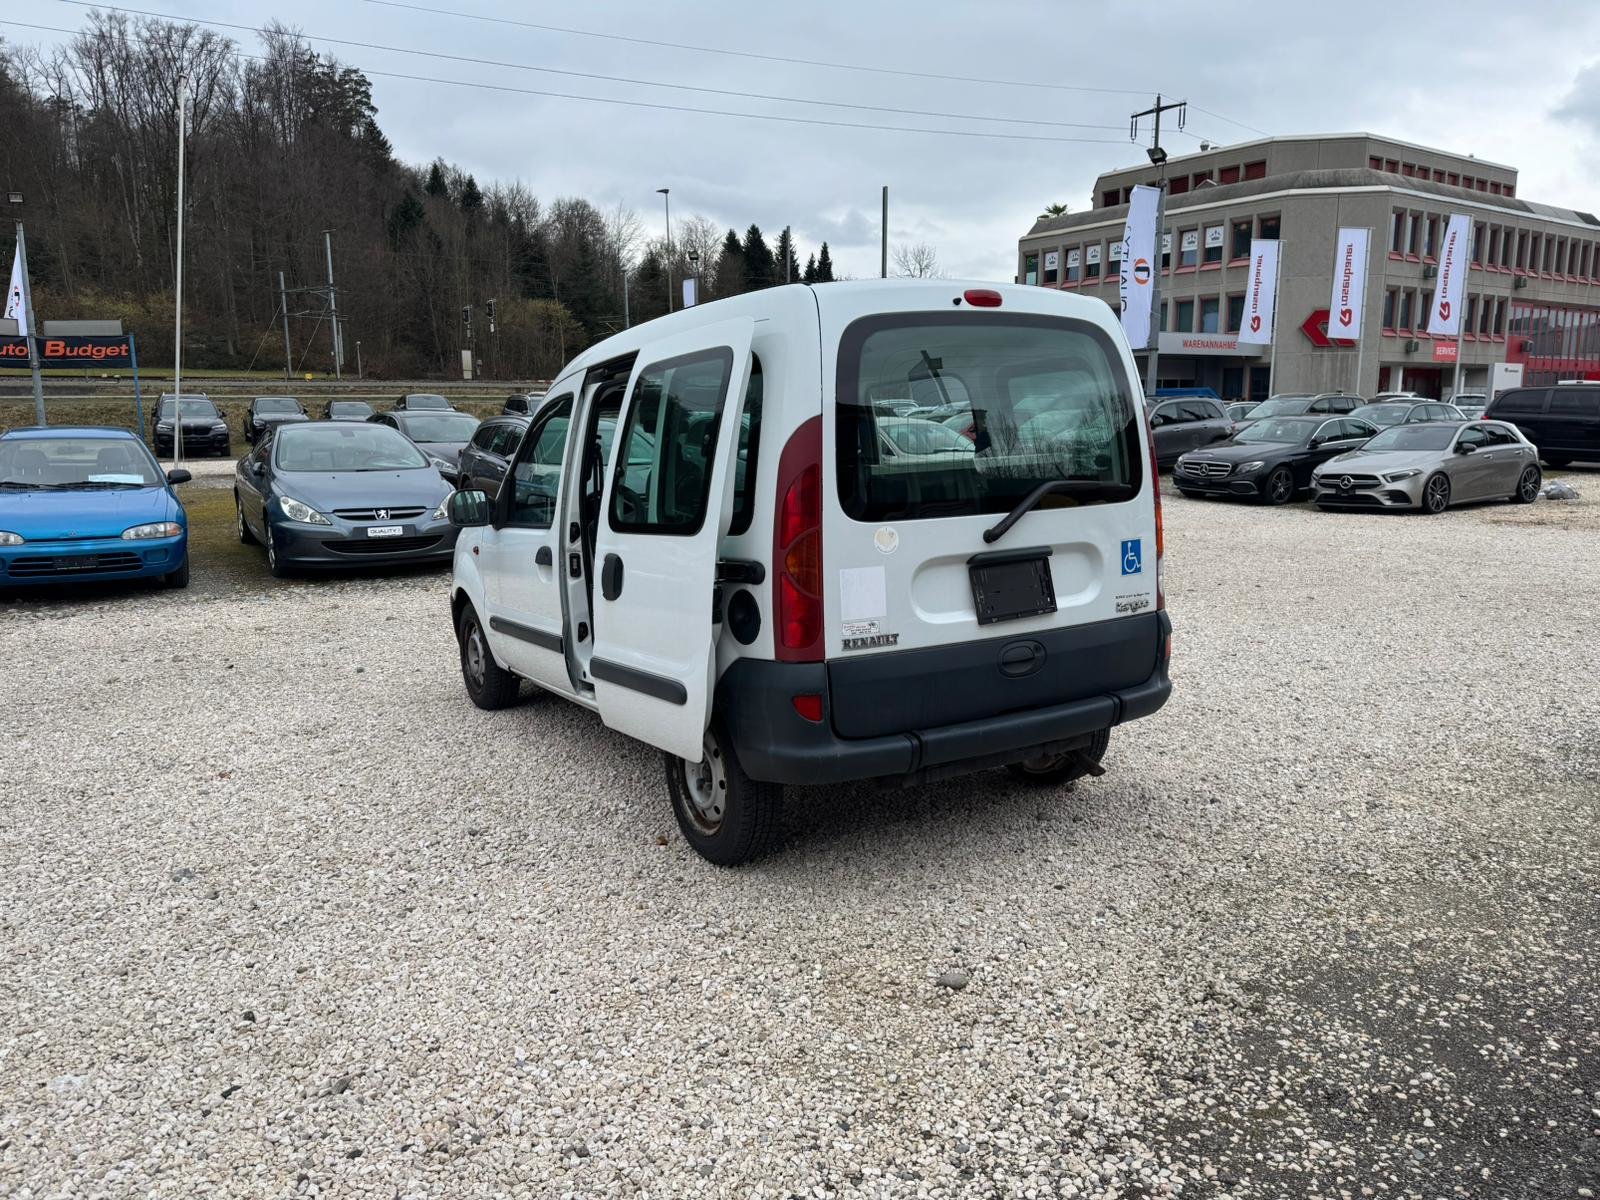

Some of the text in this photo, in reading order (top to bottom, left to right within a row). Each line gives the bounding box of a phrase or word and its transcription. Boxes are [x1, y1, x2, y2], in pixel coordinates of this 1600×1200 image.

[45, 341, 129, 358] Budget
[1183, 339, 1238, 350] WARENANNAHME
[841, 633, 899, 651] RENAULT
